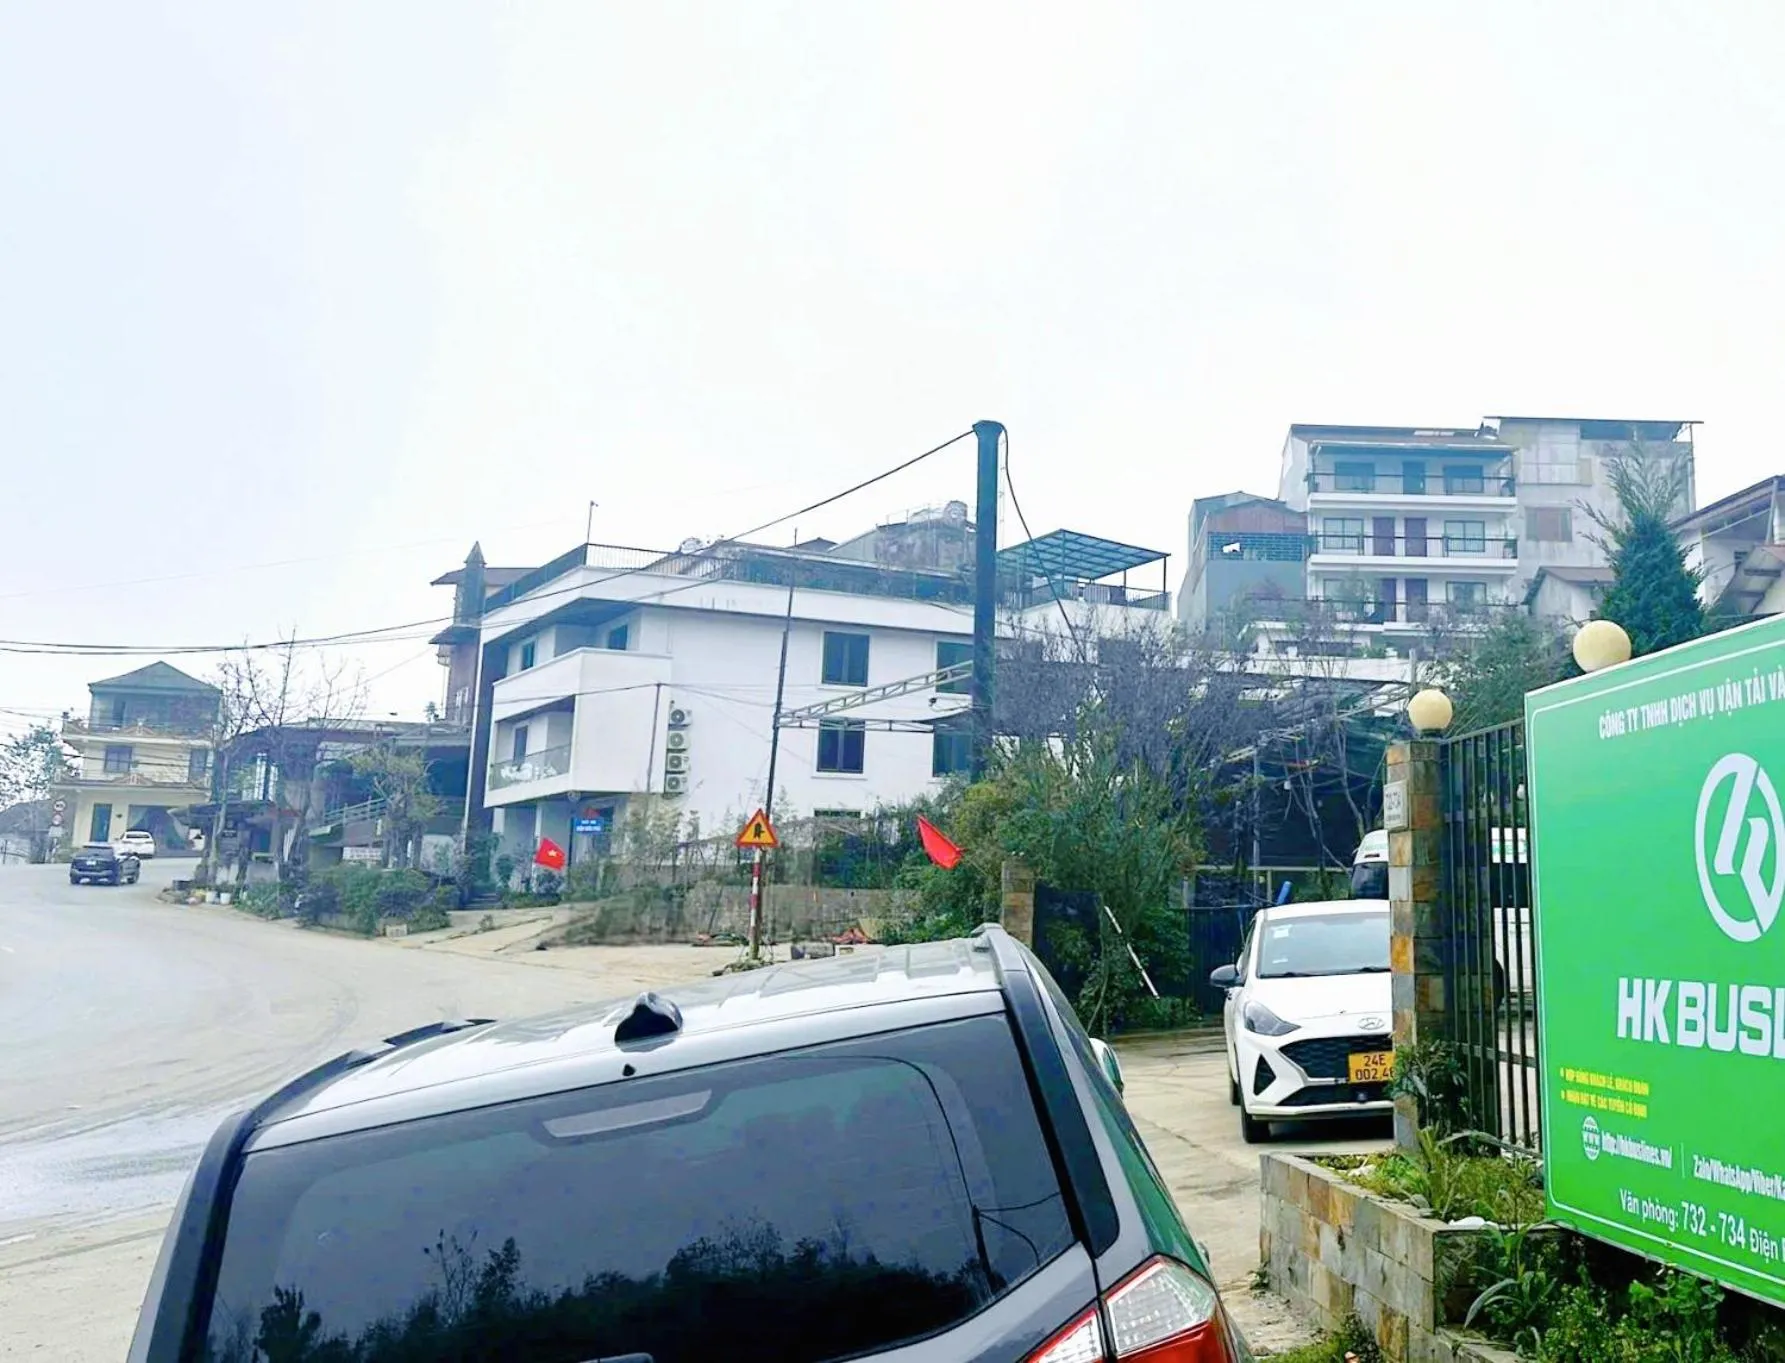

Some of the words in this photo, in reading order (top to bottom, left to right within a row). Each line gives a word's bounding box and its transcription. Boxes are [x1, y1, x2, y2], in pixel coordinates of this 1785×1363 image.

[1599, 709, 1625, 739] CÔNG
[1626, 706, 1639, 732] TY
[1640, 698, 1669, 731] TNHH
[1670, 691, 1697, 727] DỊCH
[1699, 689, 1714, 720] VỤ
[1717, 677, 1742, 717] VẬN
[1744, 667, 1766, 706] TẢI
[1364, 1054, 1386, 1067] 24E
[1619, 1188, 1640, 1214] Văn
[1641, 1197, 1679, 1233] phòng:
[1681, 1201, 1712, 1237] 732
[1718, 1212, 1746, 1249] 734
[1749, 1227, 1779, 1264] Điện
